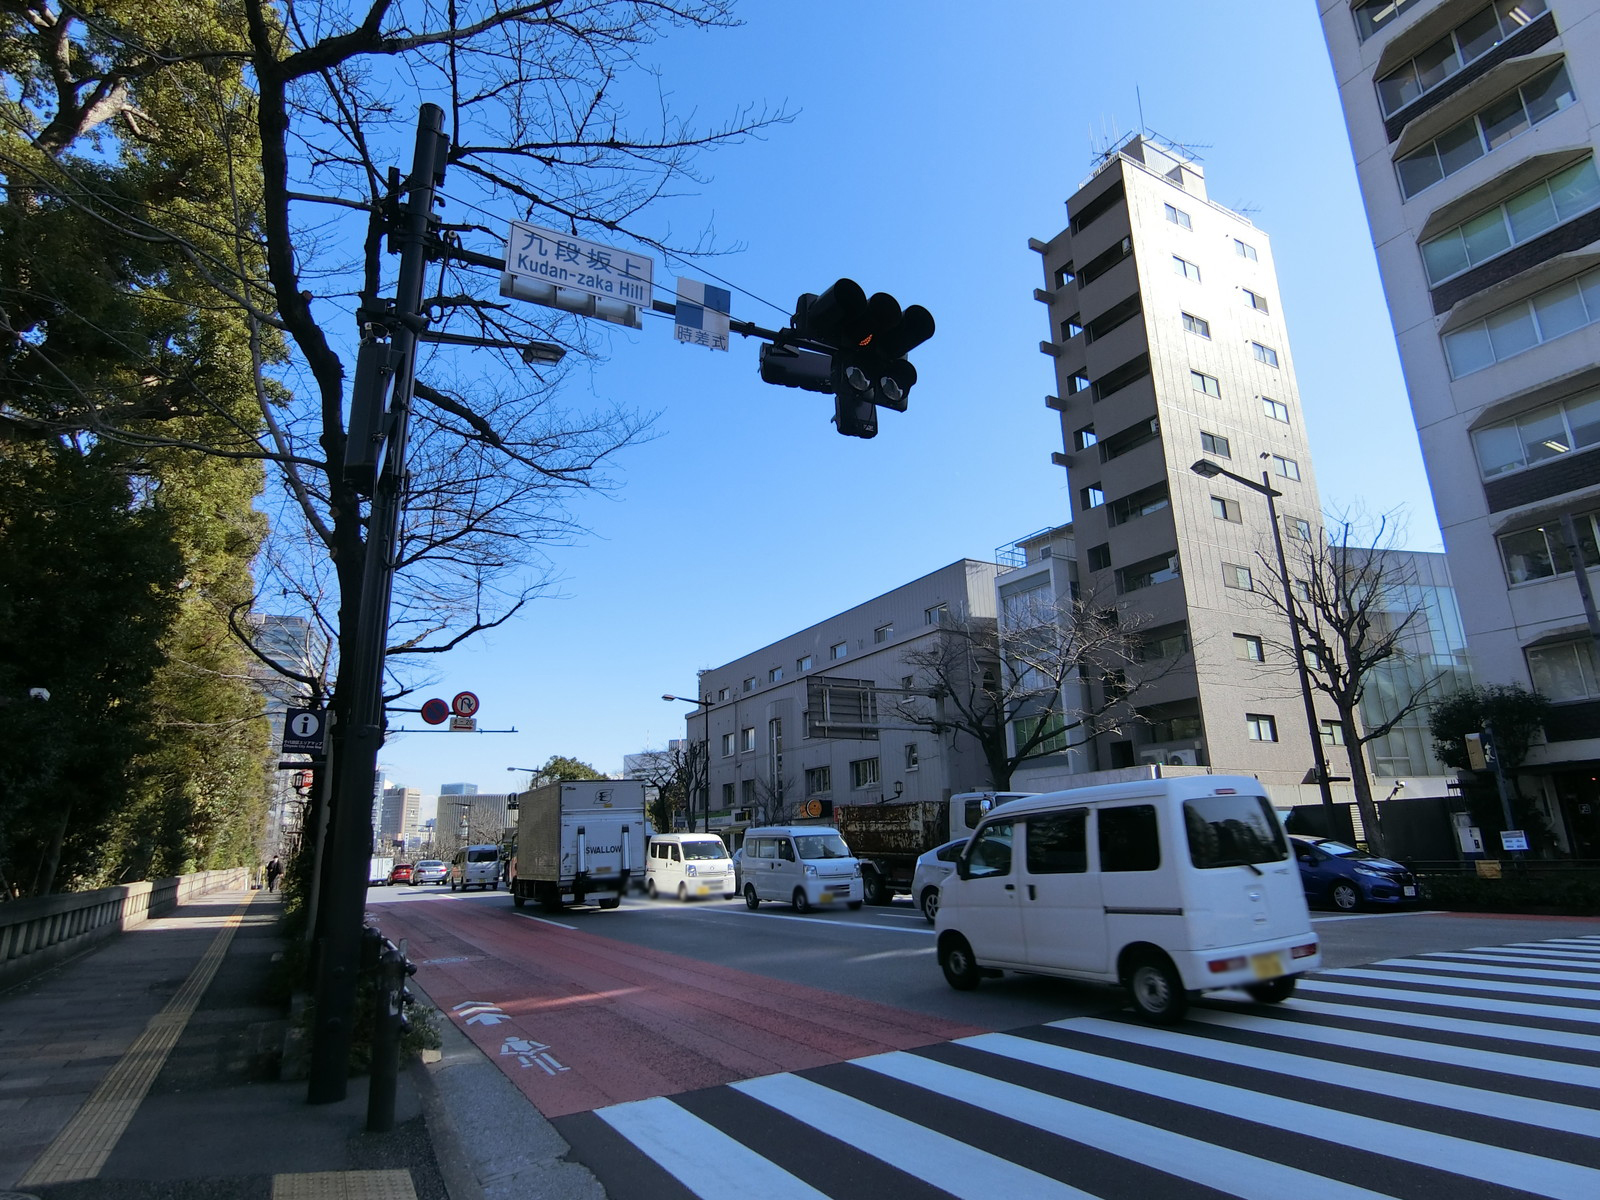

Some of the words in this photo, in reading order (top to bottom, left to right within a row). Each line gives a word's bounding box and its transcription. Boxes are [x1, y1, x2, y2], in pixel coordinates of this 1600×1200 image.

[521, 232, 642, 282] 九段坂上
[517, 253, 614, 293] Kudan-zaka
[619, 282, 643, 301] Hill
[677, 325, 726, 351] 時差式
[585, 845, 622, 855] SWALLOW
